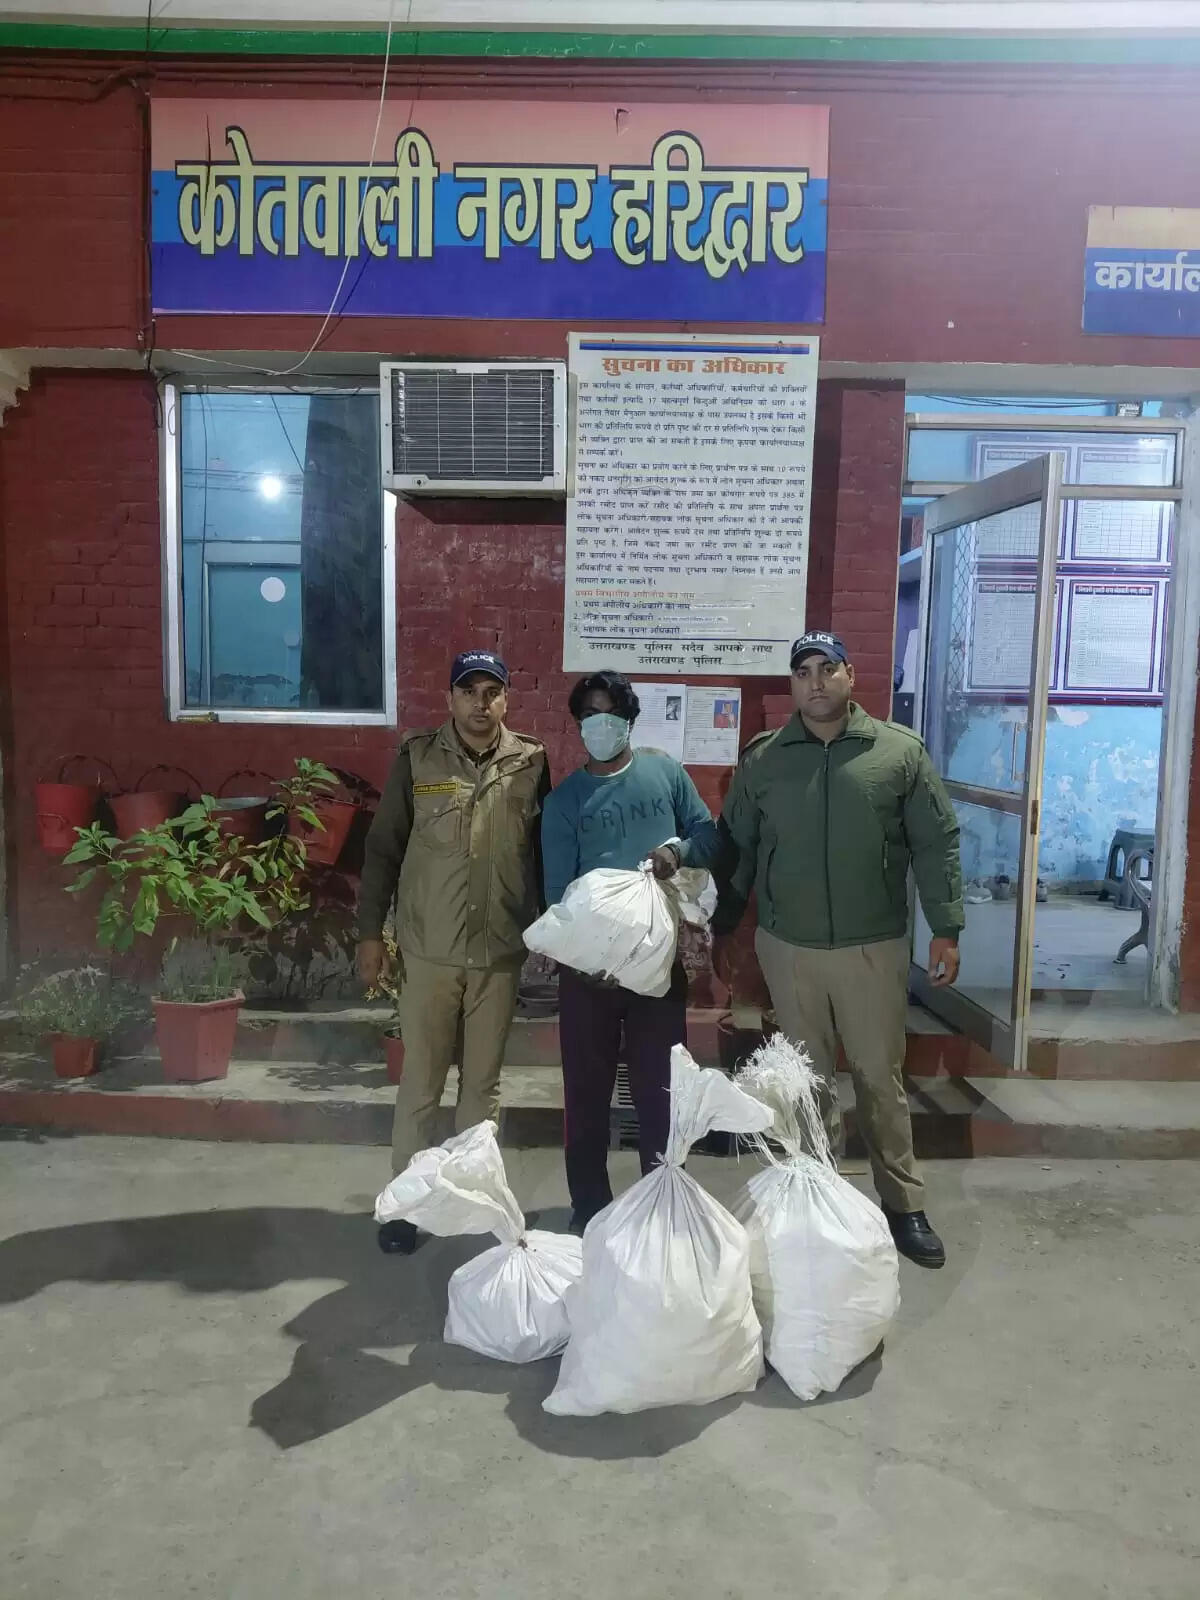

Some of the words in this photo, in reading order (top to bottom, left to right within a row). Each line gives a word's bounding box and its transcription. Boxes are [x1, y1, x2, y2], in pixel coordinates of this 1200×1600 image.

[175, 125, 439, 258] कोतवाली
[453, 163, 598, 261] नगर
[609, 129, 810, 279] हरिद्वार
[666, 359, 695, 372] का
[701, 356, 787, 374] अधिकार
[589, 642, 636, 650] उत्तराखण्ड
[644, 643, 672, 651] पुलिस
[681, 641, 704, 652] सदैव
[796, 633, 834, 648] POLICE
[463, 654, 494, 664] POLICE
[639, 656, 684, 664] उत्तराखण्ड
[692, 654, 722, 665] पुलिस
